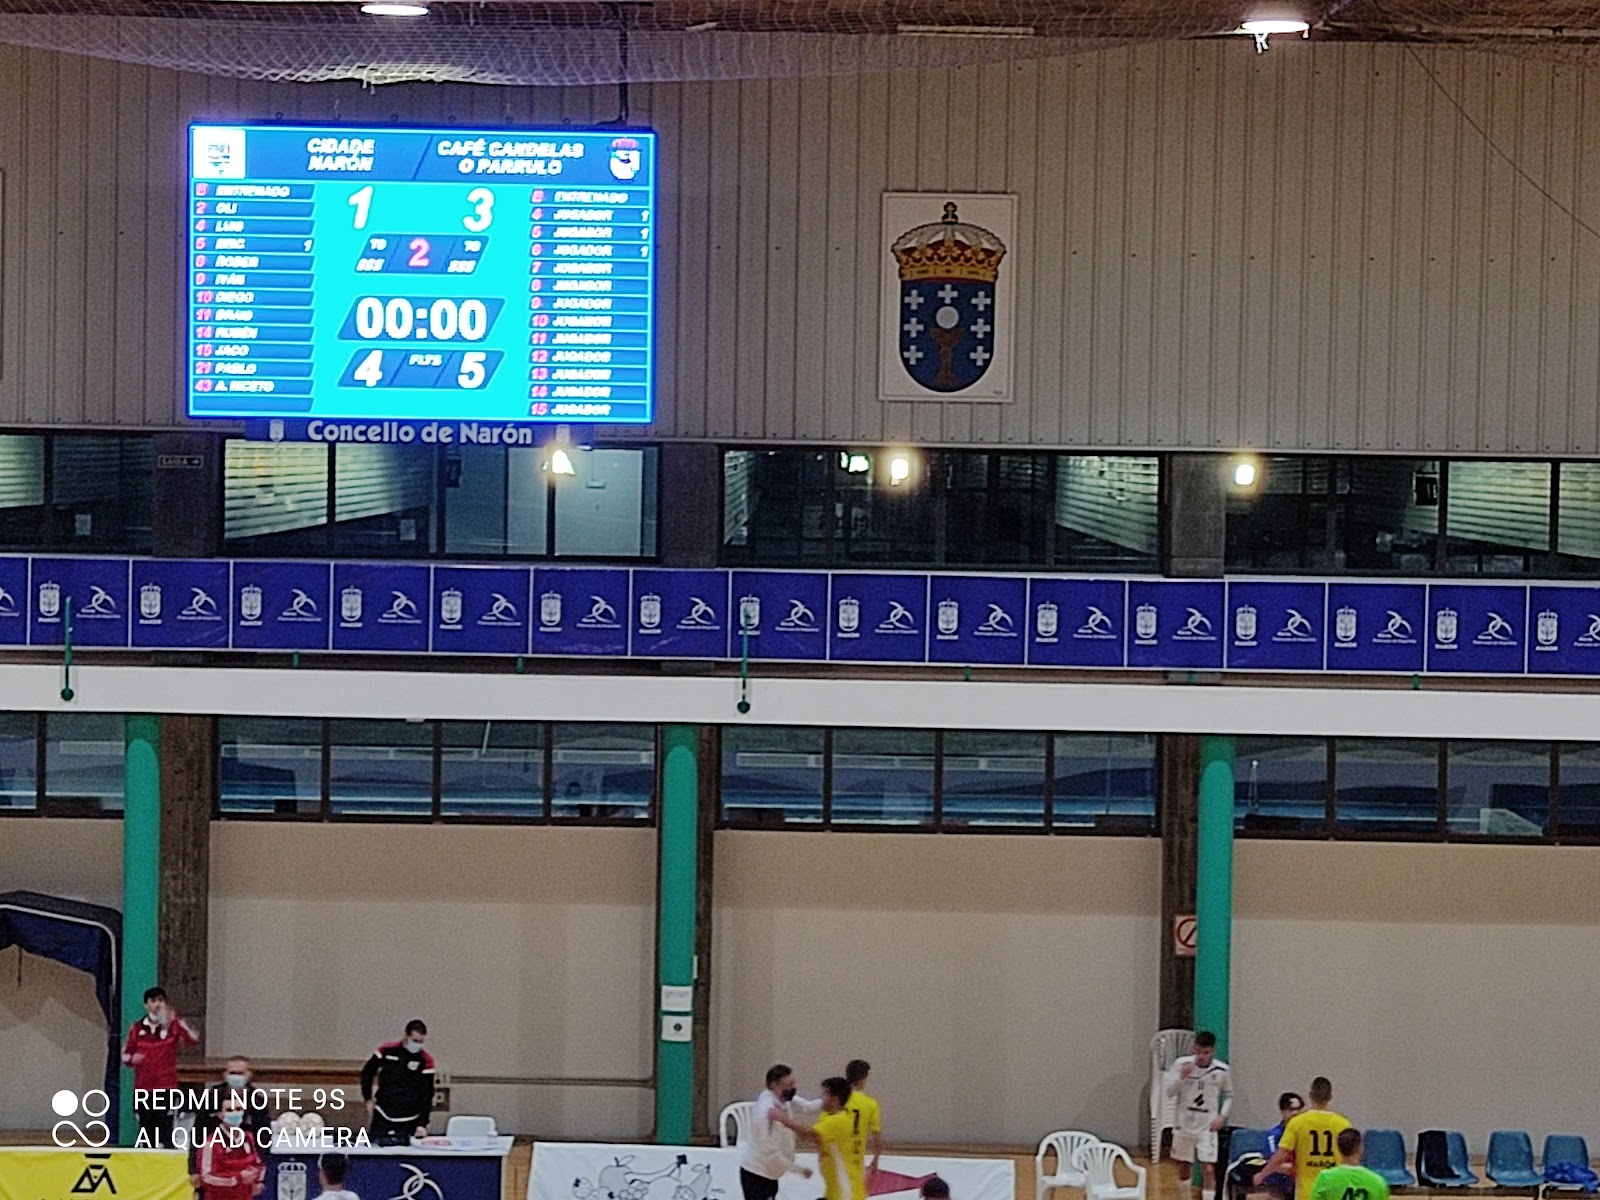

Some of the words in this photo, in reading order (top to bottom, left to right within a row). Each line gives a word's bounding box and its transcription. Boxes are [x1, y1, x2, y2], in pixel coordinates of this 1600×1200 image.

[307, 138, 375, 154] CIDADE
[438, 138, 486, 157] CAFÉ
[458, 159, 475, 173] O
[196, 202, 207, 214] 2
[349, 185, 373, 229] 1
[463, 188, 494, 232] 3
[304, 240, 312, 251] 1
[409, 238, 430, 267] 2
[532, 262, 542, 273] 7
[356, 297, 487, 340] 00:00
[354, 350, 383, 387] 4
[458, 352, 487, 388] 5
[307, 419, 415, 444] Concello
[421, 421, 453, 444] de
[459, 422, 533, 445] Narón
[1309, 1130, 1334, 1156] 11
